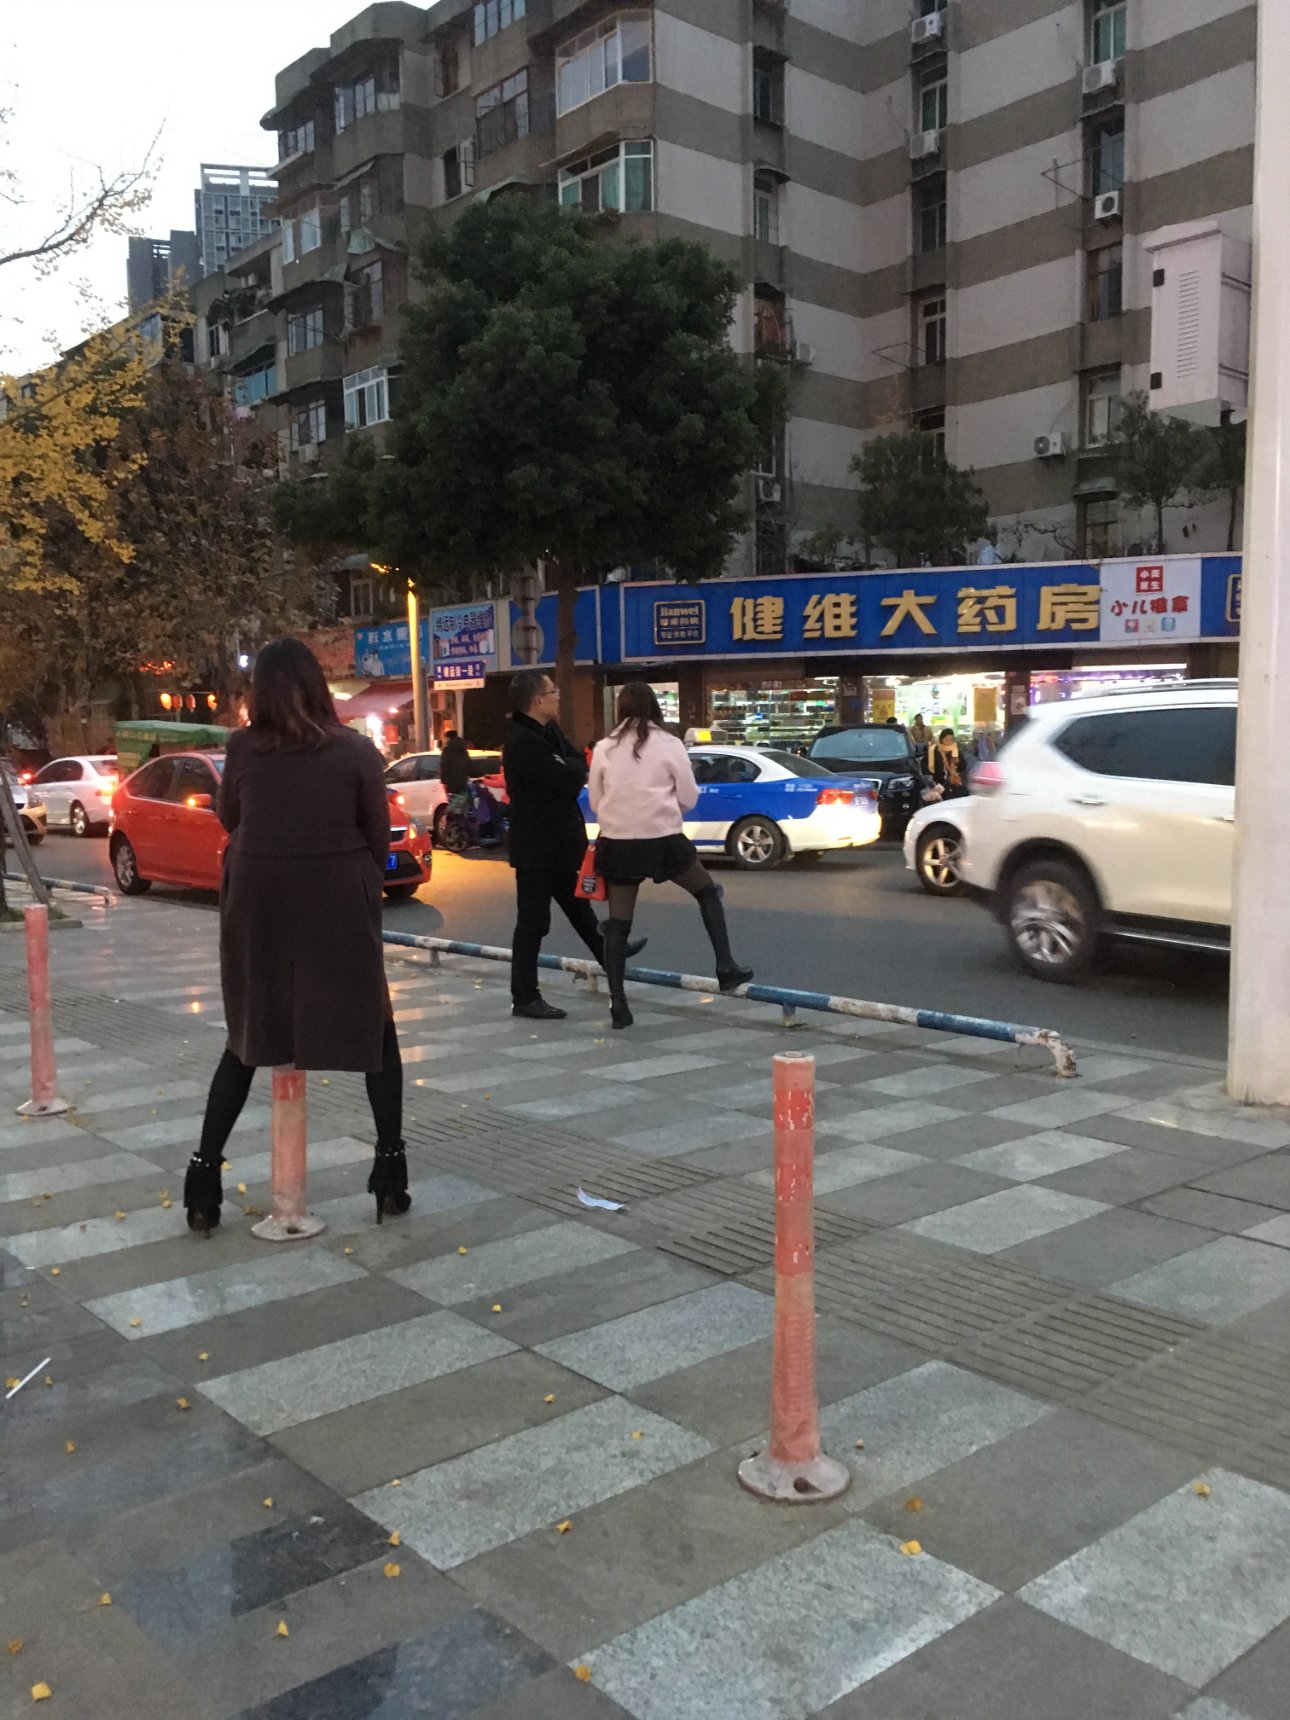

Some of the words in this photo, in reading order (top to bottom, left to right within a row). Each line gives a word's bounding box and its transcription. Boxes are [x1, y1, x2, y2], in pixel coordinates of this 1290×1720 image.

[729, 584, 1100, 641] 健维大药房
